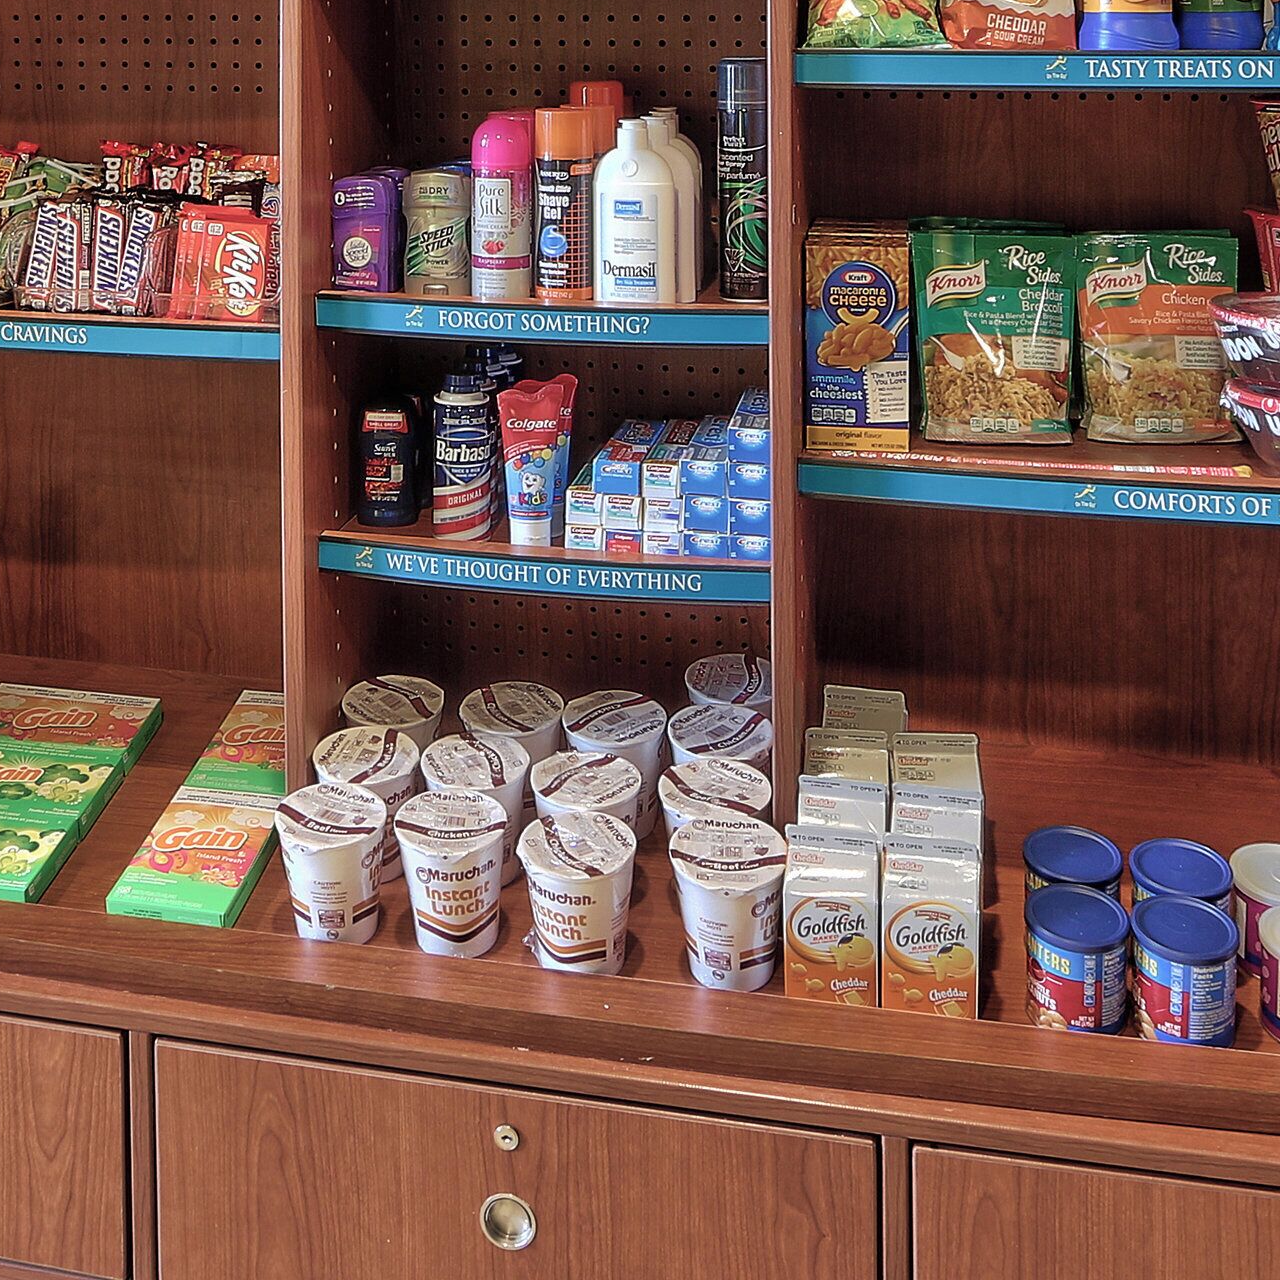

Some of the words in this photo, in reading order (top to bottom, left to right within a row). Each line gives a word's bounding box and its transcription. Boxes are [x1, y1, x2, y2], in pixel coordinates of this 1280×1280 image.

[987, 14, 1047, 36] CHEDDAR
[993, 30, 1015, 42] SOUR
[1017, 34, 1045, 46] CREAM
[1084, 59, 1150, 79] TASTY
[1154, 59, 1232, 79] TREATS
[1237, 59, 1274, 79] ON
[479, 185, 504, 197] Pure
[539, 193, 569, 207] Shave
[479, 198, 504, 218] Silk
[544, 206, 561, 220] Gel
[420, 225, 454, 244] SPEED
[423, 235, 455, 254] STICK
[999, 244, 1046, 270] Rice
[1164, 244, 1206, 269] Rice
[602, 260, 657, 278] Dermasil
[848, 273, 868, 283] Kraft
[928, 273, 983, 294] Knorr
[1090, 273, 1144, 293] Knorr
[830, 286, 879, 296] macaroni
[1018, 288, 1064, 302] Cheddar
[1162, 292, 1206, 306] Chicken
[438, 311, 516, 331] FORGOT
[520, 313, 651, 335] SOMETHING?
[1, 322, 88, 345] CRAVINGS
[810, 390, 863, 401] cheesiest
[506, 418, 557, 431] Colgate
[836, 430, 863, 439] original
[864, 431, 882, 439] flavor
[448, 489, 483, 506] ORIGINAL
[517, 492, 547, 506] Kids
[1113, 490, 1235, 515] COMFORTS
[1241, 497, 1271, 517] OF
[386, 552, 439, 574] WE'VE
[443, 558, 541, 584] THOUGHT
[545, 567, 571, 585] OF
[577, 570, 702, 592] EVERYTHING
[12, 706, 98, 731] Gain
[306, 821, 330, 834] Beef
[704, 819, 759, 830] Maruchan
[153, 826, 248, 852] Gain
[427, 829, 470, 839] Chicken
[196, 852, 219, 861] Island
[219, 853, 244, 864] Fresh
[890, 860, 924, 872] Cheddar
[426, 879, 489, 902] Instant
[431, 898, 485, 917] Lunch
[812, 934, 838, 942] BAKED
[911, 944, 939, 952] BAKED
[830, 978, 869, 990] Cheddar
[928, 989, 968, 1001] Cheddar
